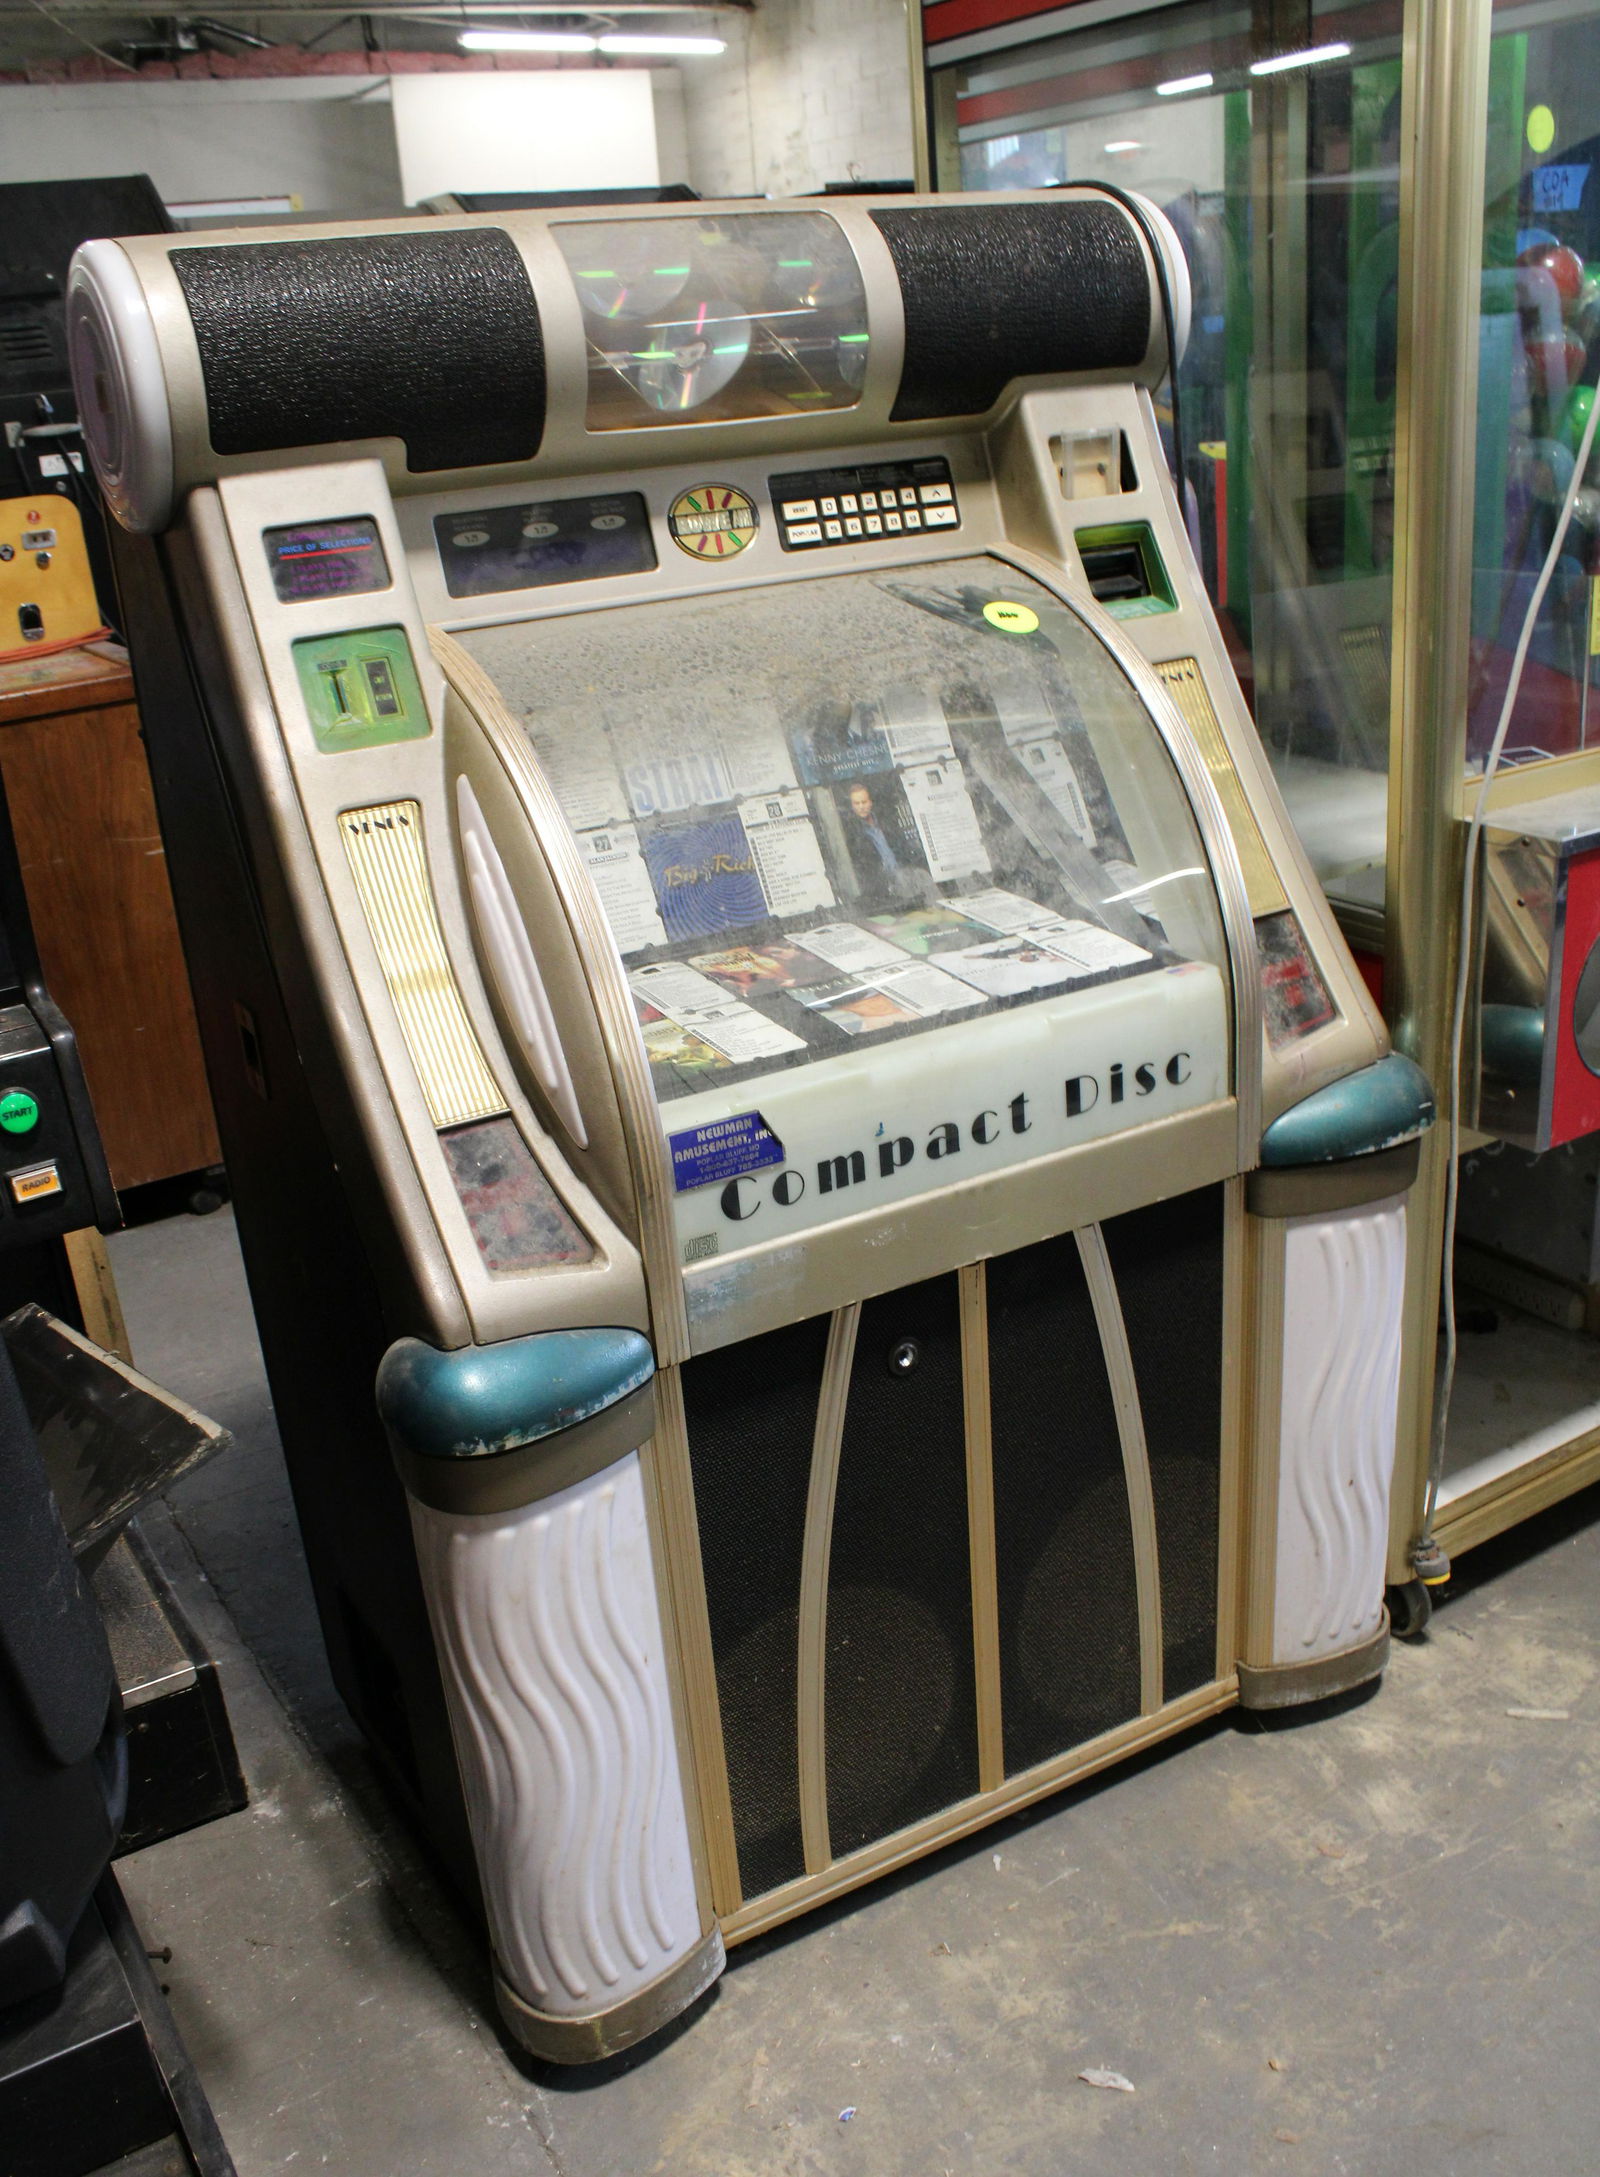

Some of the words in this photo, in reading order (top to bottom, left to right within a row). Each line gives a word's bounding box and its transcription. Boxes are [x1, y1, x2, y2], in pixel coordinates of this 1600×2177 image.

[826, 501, 833, 511] 0
[885, 494, 893, 503] 3
[905, 492, 913, 500] 4
[830, 525, 838, 534] 5
[850, 522, 859, 531] 6
[869, 520, 877, 529] 7
[890, 517, 898, 526] 8
[909, 514, 917, 523] 9
[278, 544, 304, 555] PRICE
[305, 543, 317, 551] OF
[319, 536, 373, 550] SELECTIONS
[626, 751, 724, 812] STRAI
[2, 1105, 33, 1121] START
[696, 1117, 753, 1142] NEWMAN
[720, 1091, 1033, 1222] Compact
[1064, 1052, 1192, 1119] Disc
[674, 1133, 752, 1163] AMUSEMENT,
[22, 1176, 51, 1192] RADIO
